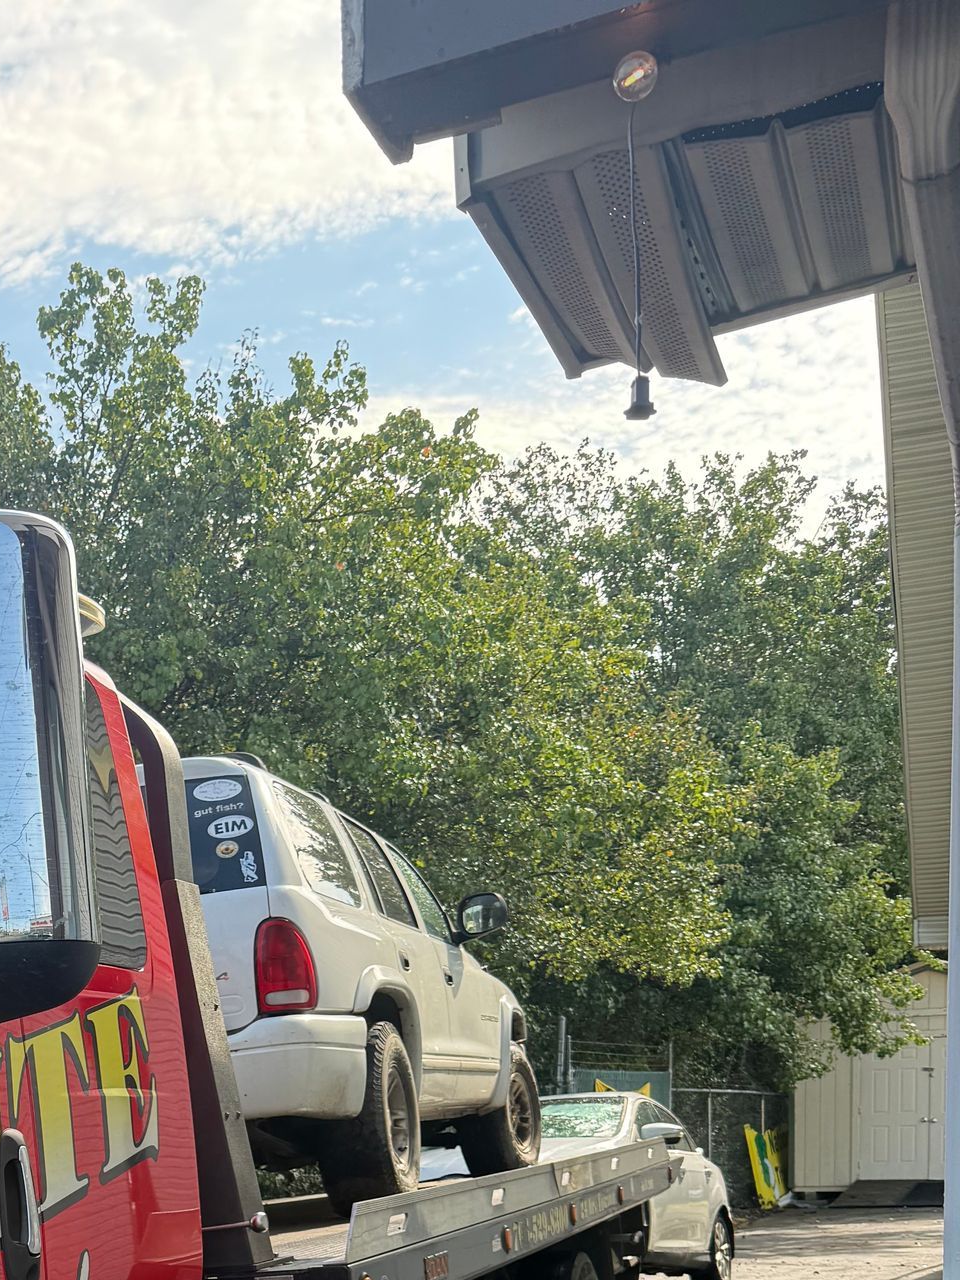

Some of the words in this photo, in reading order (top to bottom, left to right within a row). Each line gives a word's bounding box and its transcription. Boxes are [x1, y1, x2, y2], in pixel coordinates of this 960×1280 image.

[194, 806, 213, 818] gut
[215, 802, 244, 812] fish?
[214, 819, 248, 835] EIM
